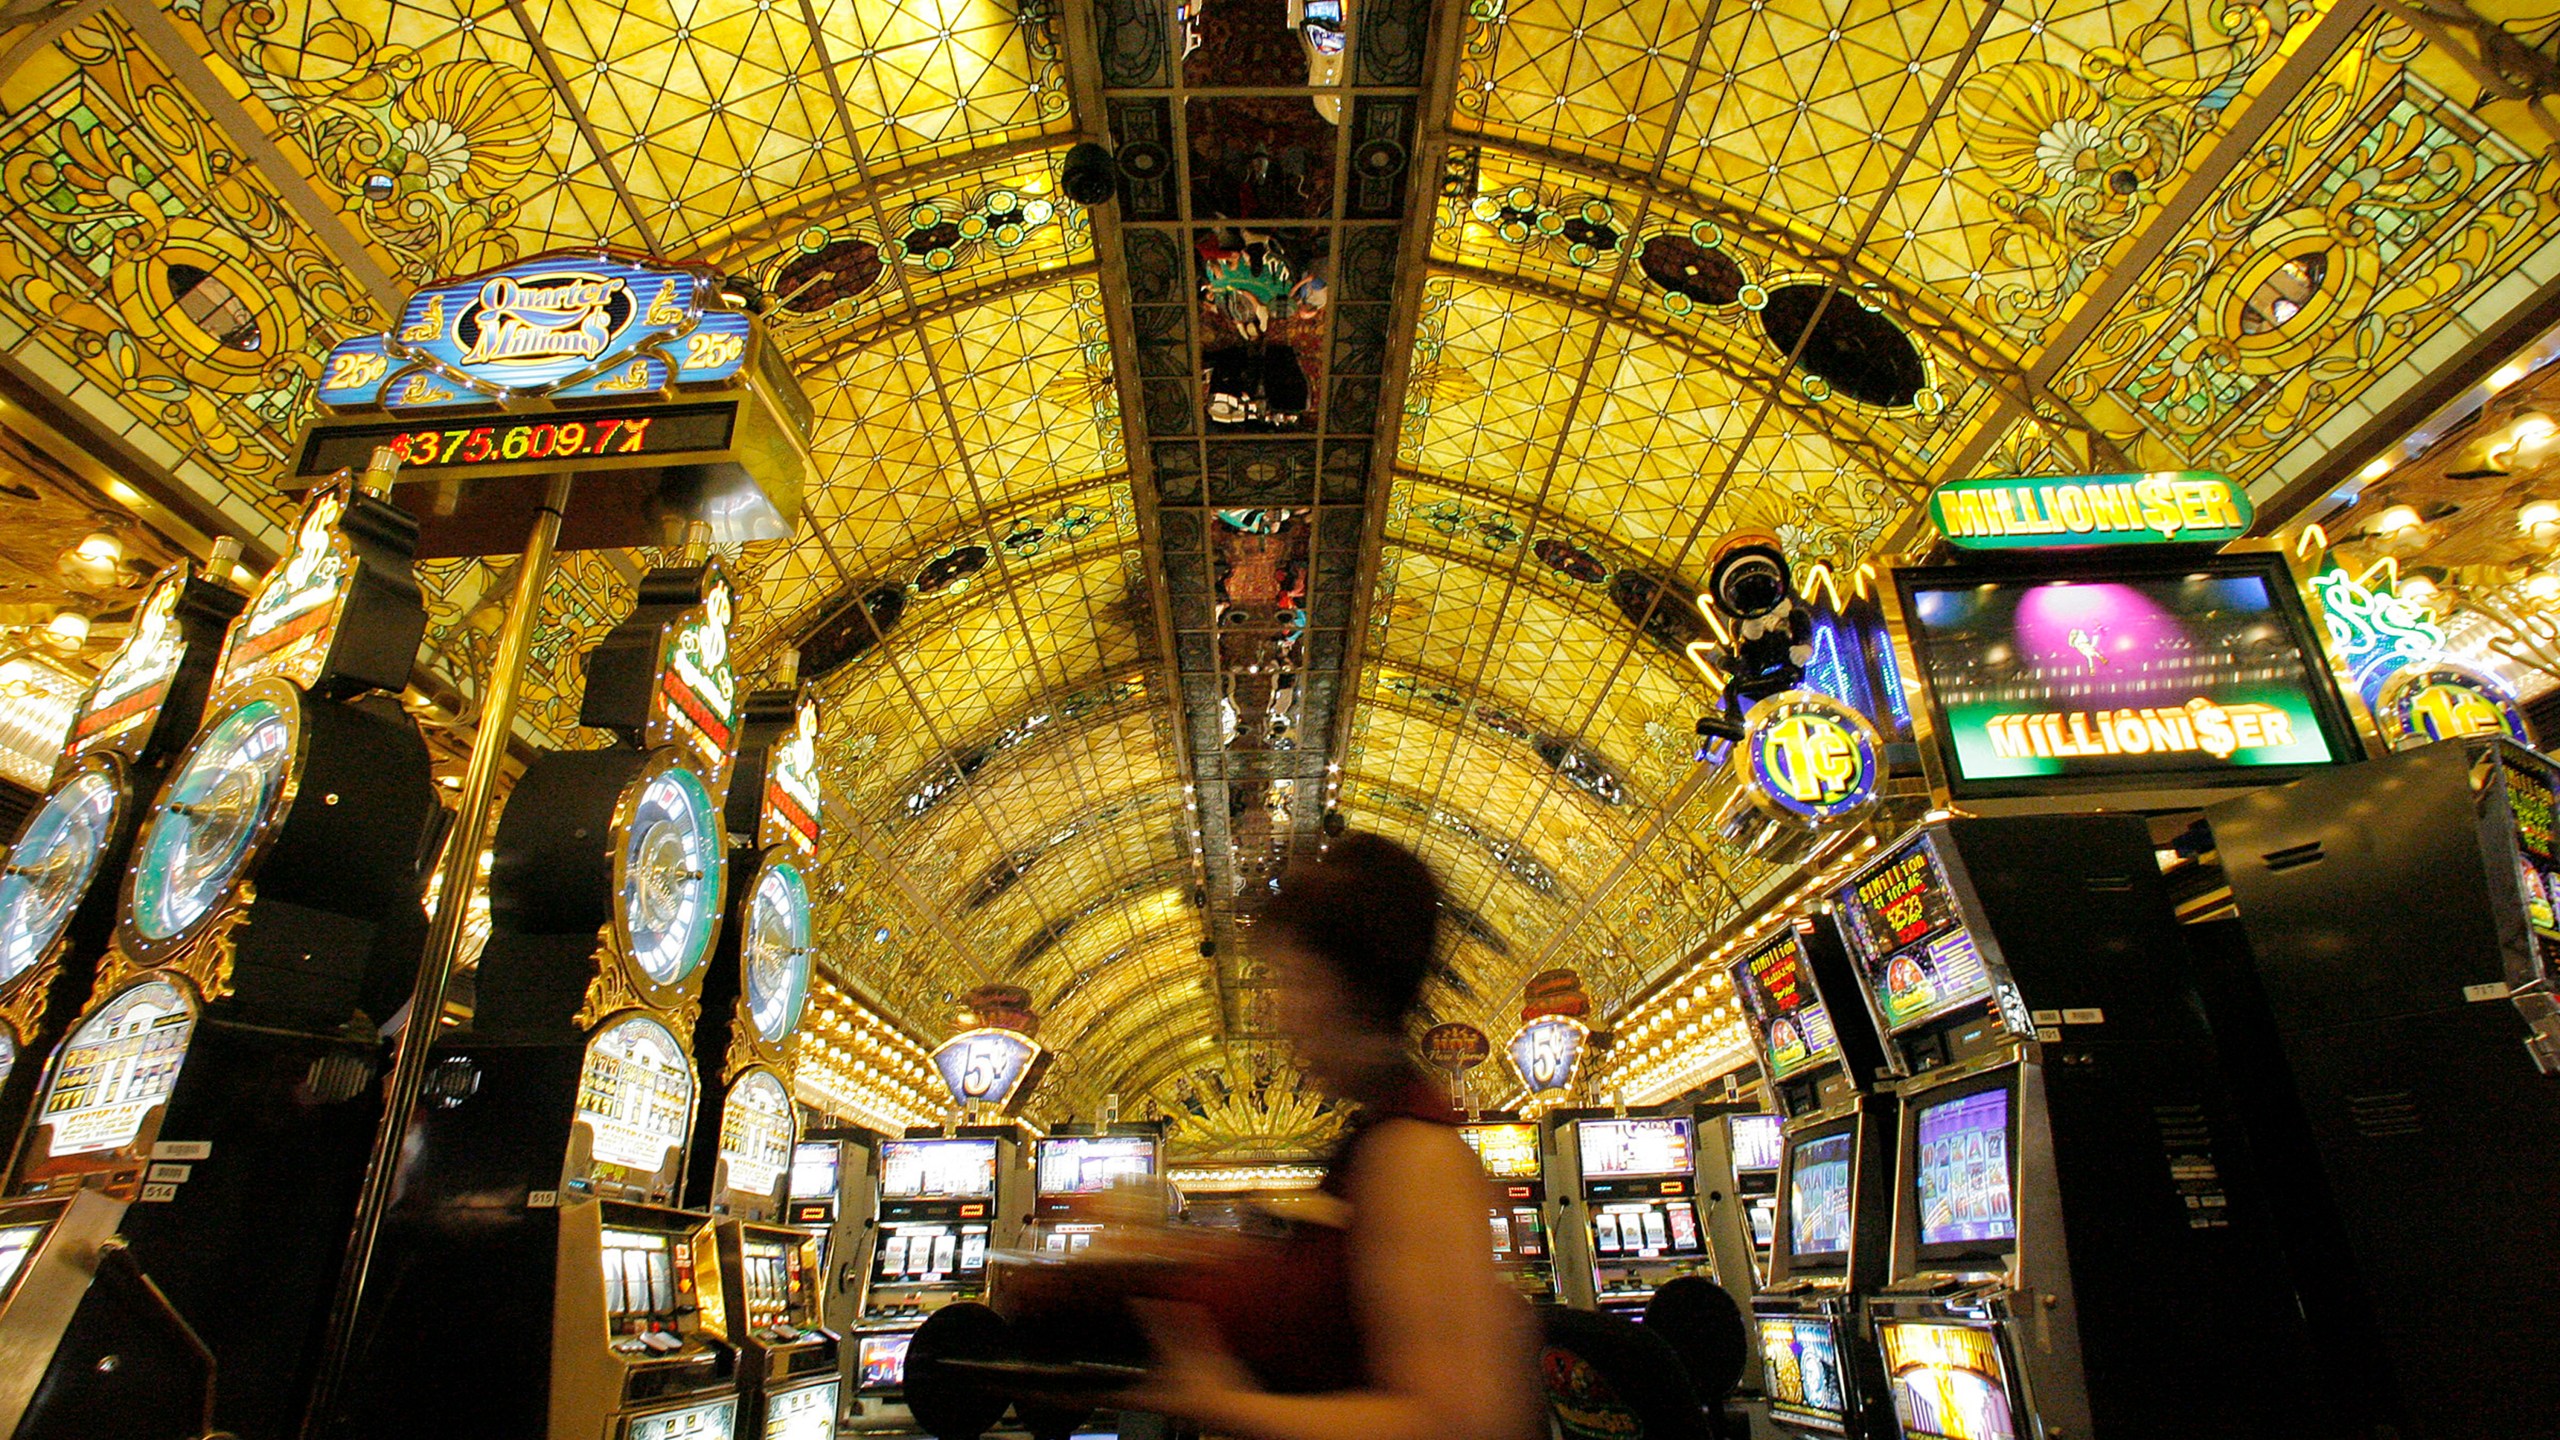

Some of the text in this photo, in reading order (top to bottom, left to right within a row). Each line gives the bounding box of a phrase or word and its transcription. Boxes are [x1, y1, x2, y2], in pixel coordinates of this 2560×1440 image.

[480, 276, 626, 327] Quarter
[461, 304, 612, 366] Million$
[682, 331, 745, 372] 25¢
[324, 351, 388, 391] 25¢
[1937, 471, 2245, 539] MILLIONI$ER
[1986, 697, 2298, 759] MILLIONI$ER
[1768, 715, 1855, 802] 1¢
[962, 1038, 1008, 1097] 5¢
[1532, 1024, 1565, 1082] 5¢
[146, 1185, 172, 1198] 514
